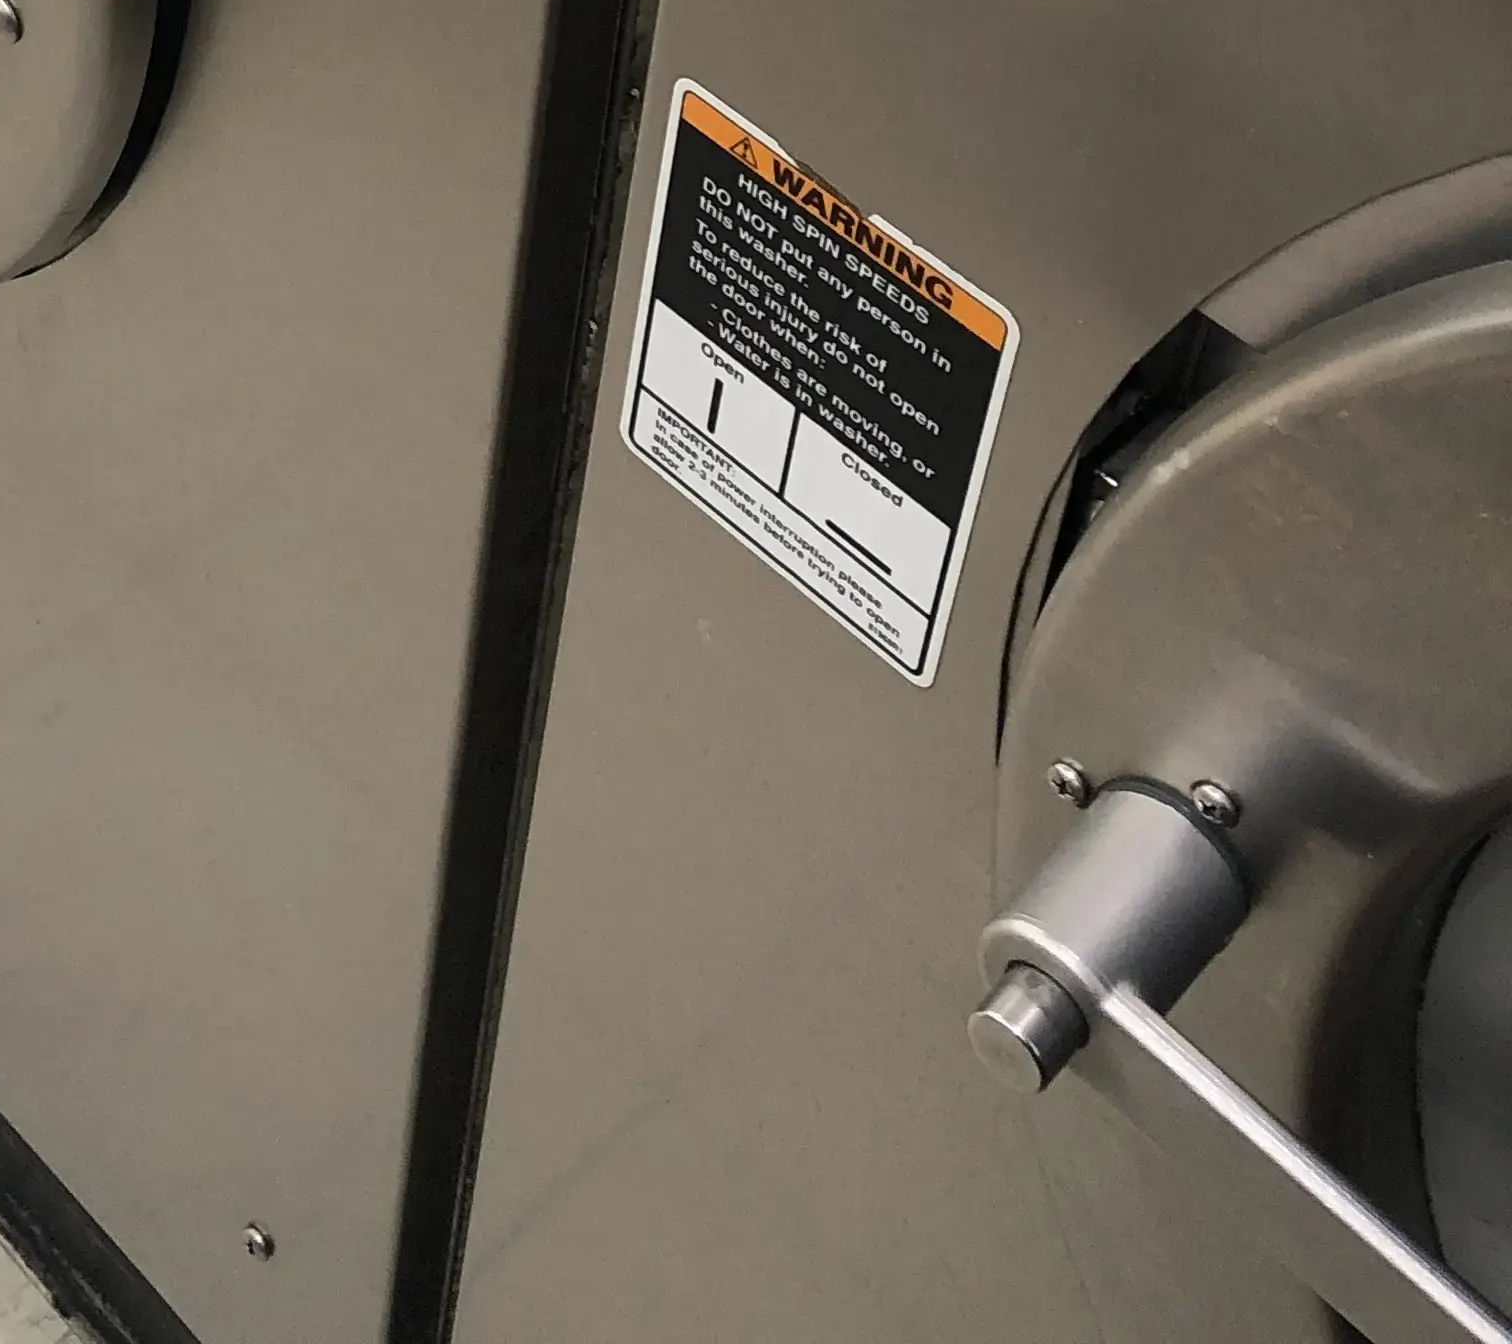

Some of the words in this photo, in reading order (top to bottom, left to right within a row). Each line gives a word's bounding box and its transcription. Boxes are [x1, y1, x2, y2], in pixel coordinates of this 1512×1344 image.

[695, 217, 717, 245] To
[721, 240, 786, 298] reduce
[789, 291, 821, 323] the
[824, 319, 862, 355] risk
[865, 349, 888, 373] of
[698, 195, 733, 230] this
[737, 226, 810, 289] washer.
[702, 175, 732, 207] DO
[736, 201, 778, 239] NOT
[781, 238, 815, 271] put
[817, 264, 853, 301] any
[856, 294, 927, 354] person
[931, 348, 952, 373] in
[738, 173, 788, 220] HIGH
[792, 213, 840, 258] SPIN
[843, 255, 929, 324] SPEEDS
[772, 157, 954, 311] WARNING
[689, 256, 718, 286] the
[721, 281, 766, 320] door
[769, 314, 826, 370] when:
[691, 241, 759, 299] serious
[763, 290, 819, 345] injury
[822, 337, 849, 365] do
[852, 363, 886, 394] not
[889, 390, 940, 436] open
[700, 341, 745, 384] Open
[650, 444, 683, 476] door.
[718, 323, 771, 372] Water
[773, 368, 790, 389] is
[795, 387, 813, 407] in
[818, 403, 890, 467] washer.
[721, 307, 792, 371] Clothes
[796, 366, 827, 397] are
[831, 393, 908, 463] moving,
[911, 457, 937, 480] or
[653, 433, 686, 464] allow
[687, 460, 708, 481] 2-3
[709, 477, 761, 525] minutes
[763, 521, 806, 560] before
[808, 557, 846, 596] trying
[849, 591, 864, 608] to
[866, 605, 900, 639] open
[655, 419, 669, 432] In
[669, 426, 700, 456] case
[702, 453, 716, 473] of
[717, 468, 758, 506] power
[759, 504, 835, 572] interruption
[838, 569, 883, 610] please
[841, 452, 904, 508] Closed
